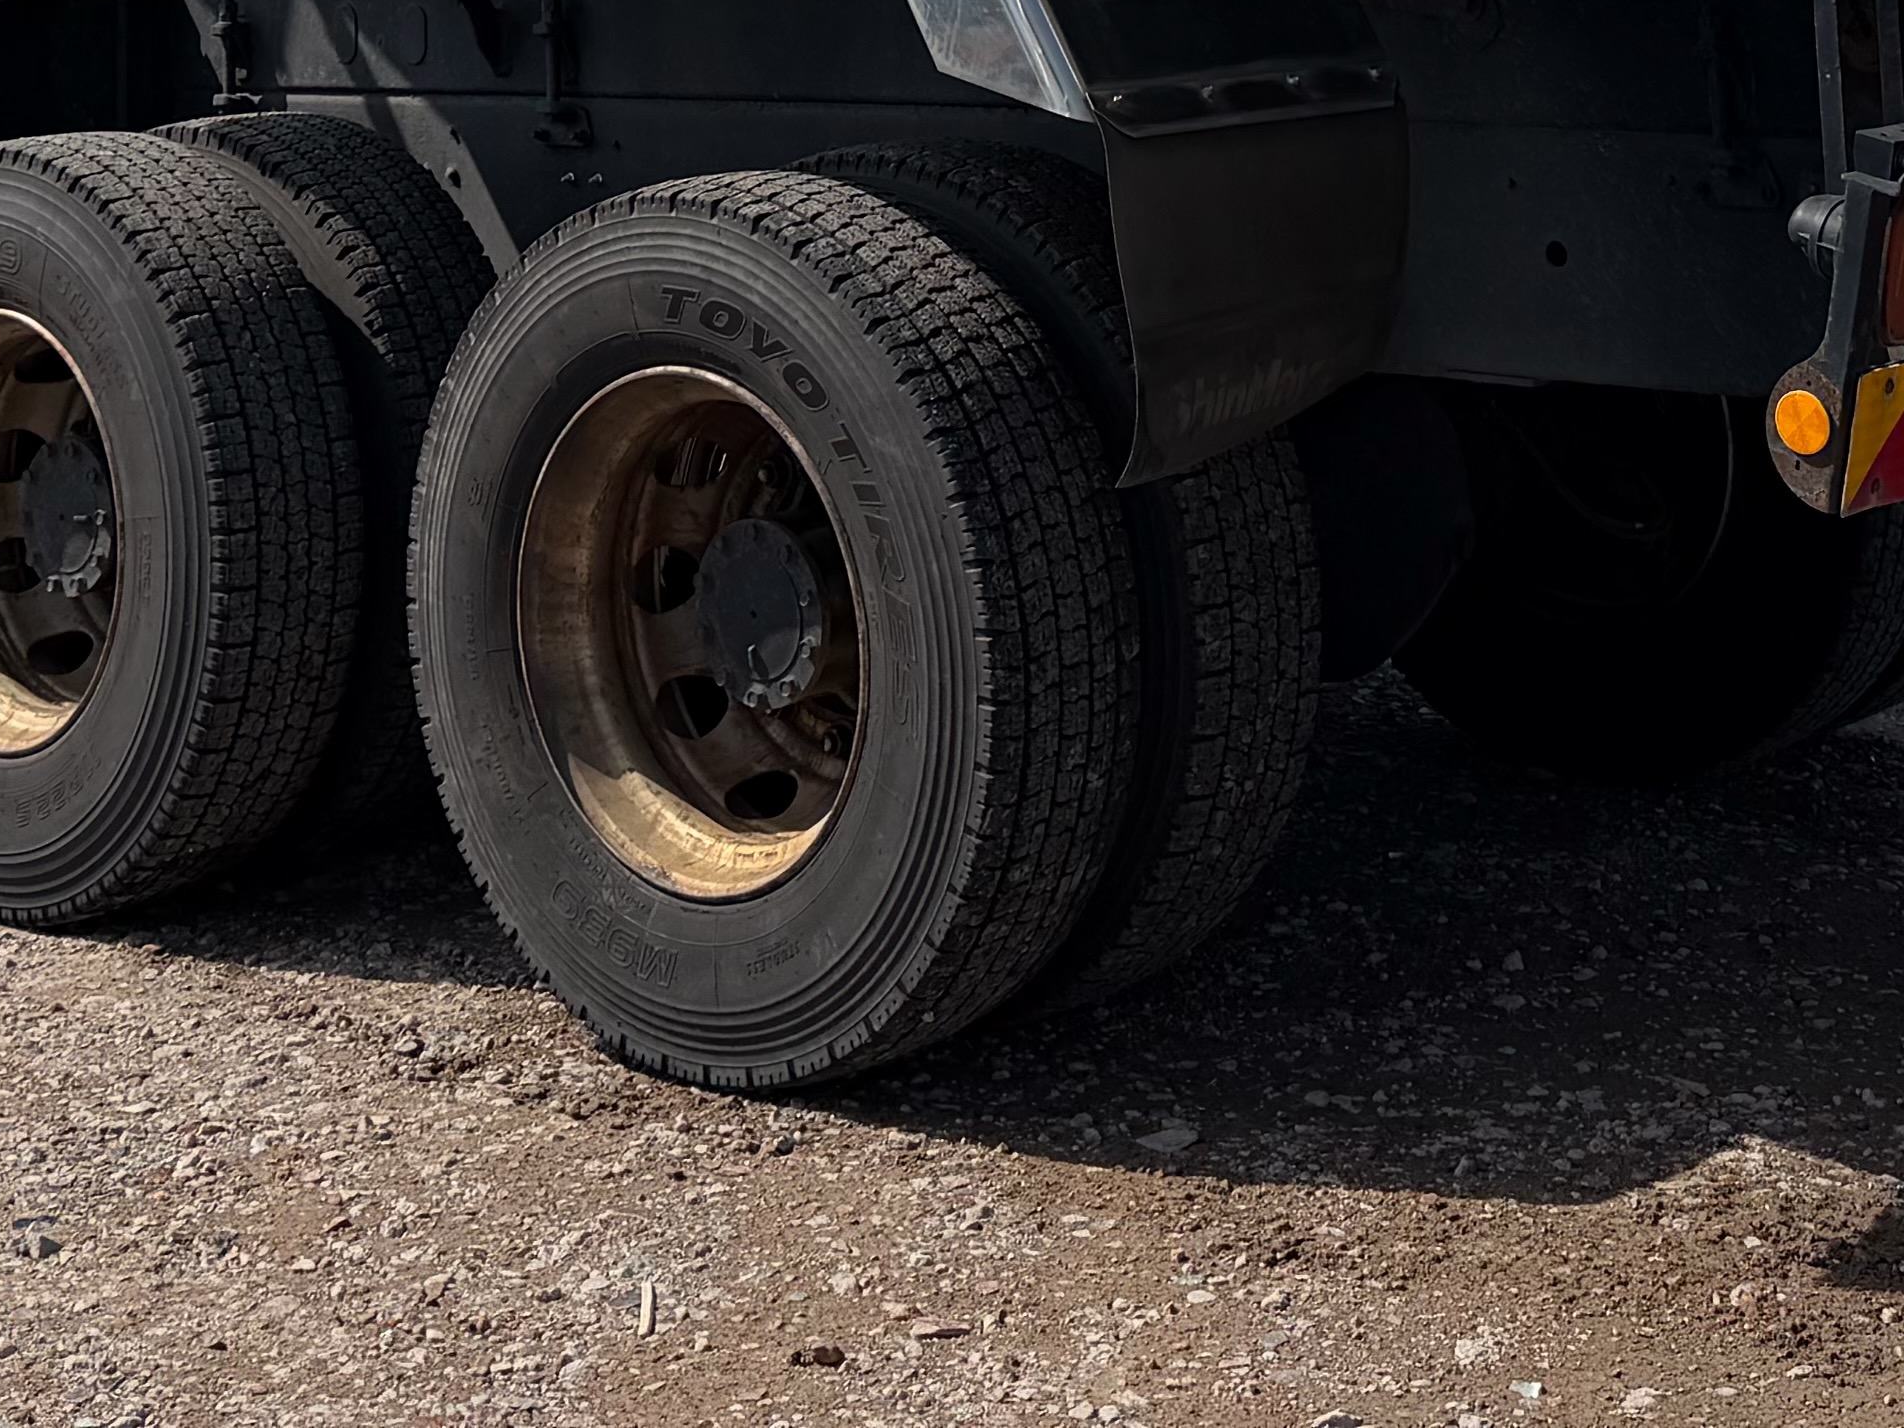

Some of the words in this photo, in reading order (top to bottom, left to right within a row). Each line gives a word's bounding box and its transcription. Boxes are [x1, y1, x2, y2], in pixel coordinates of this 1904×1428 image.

[659, 285, 830, 412] TOYO
[828, 420, 921, 734] TIRES
[551, 879, 680, 988] M939
